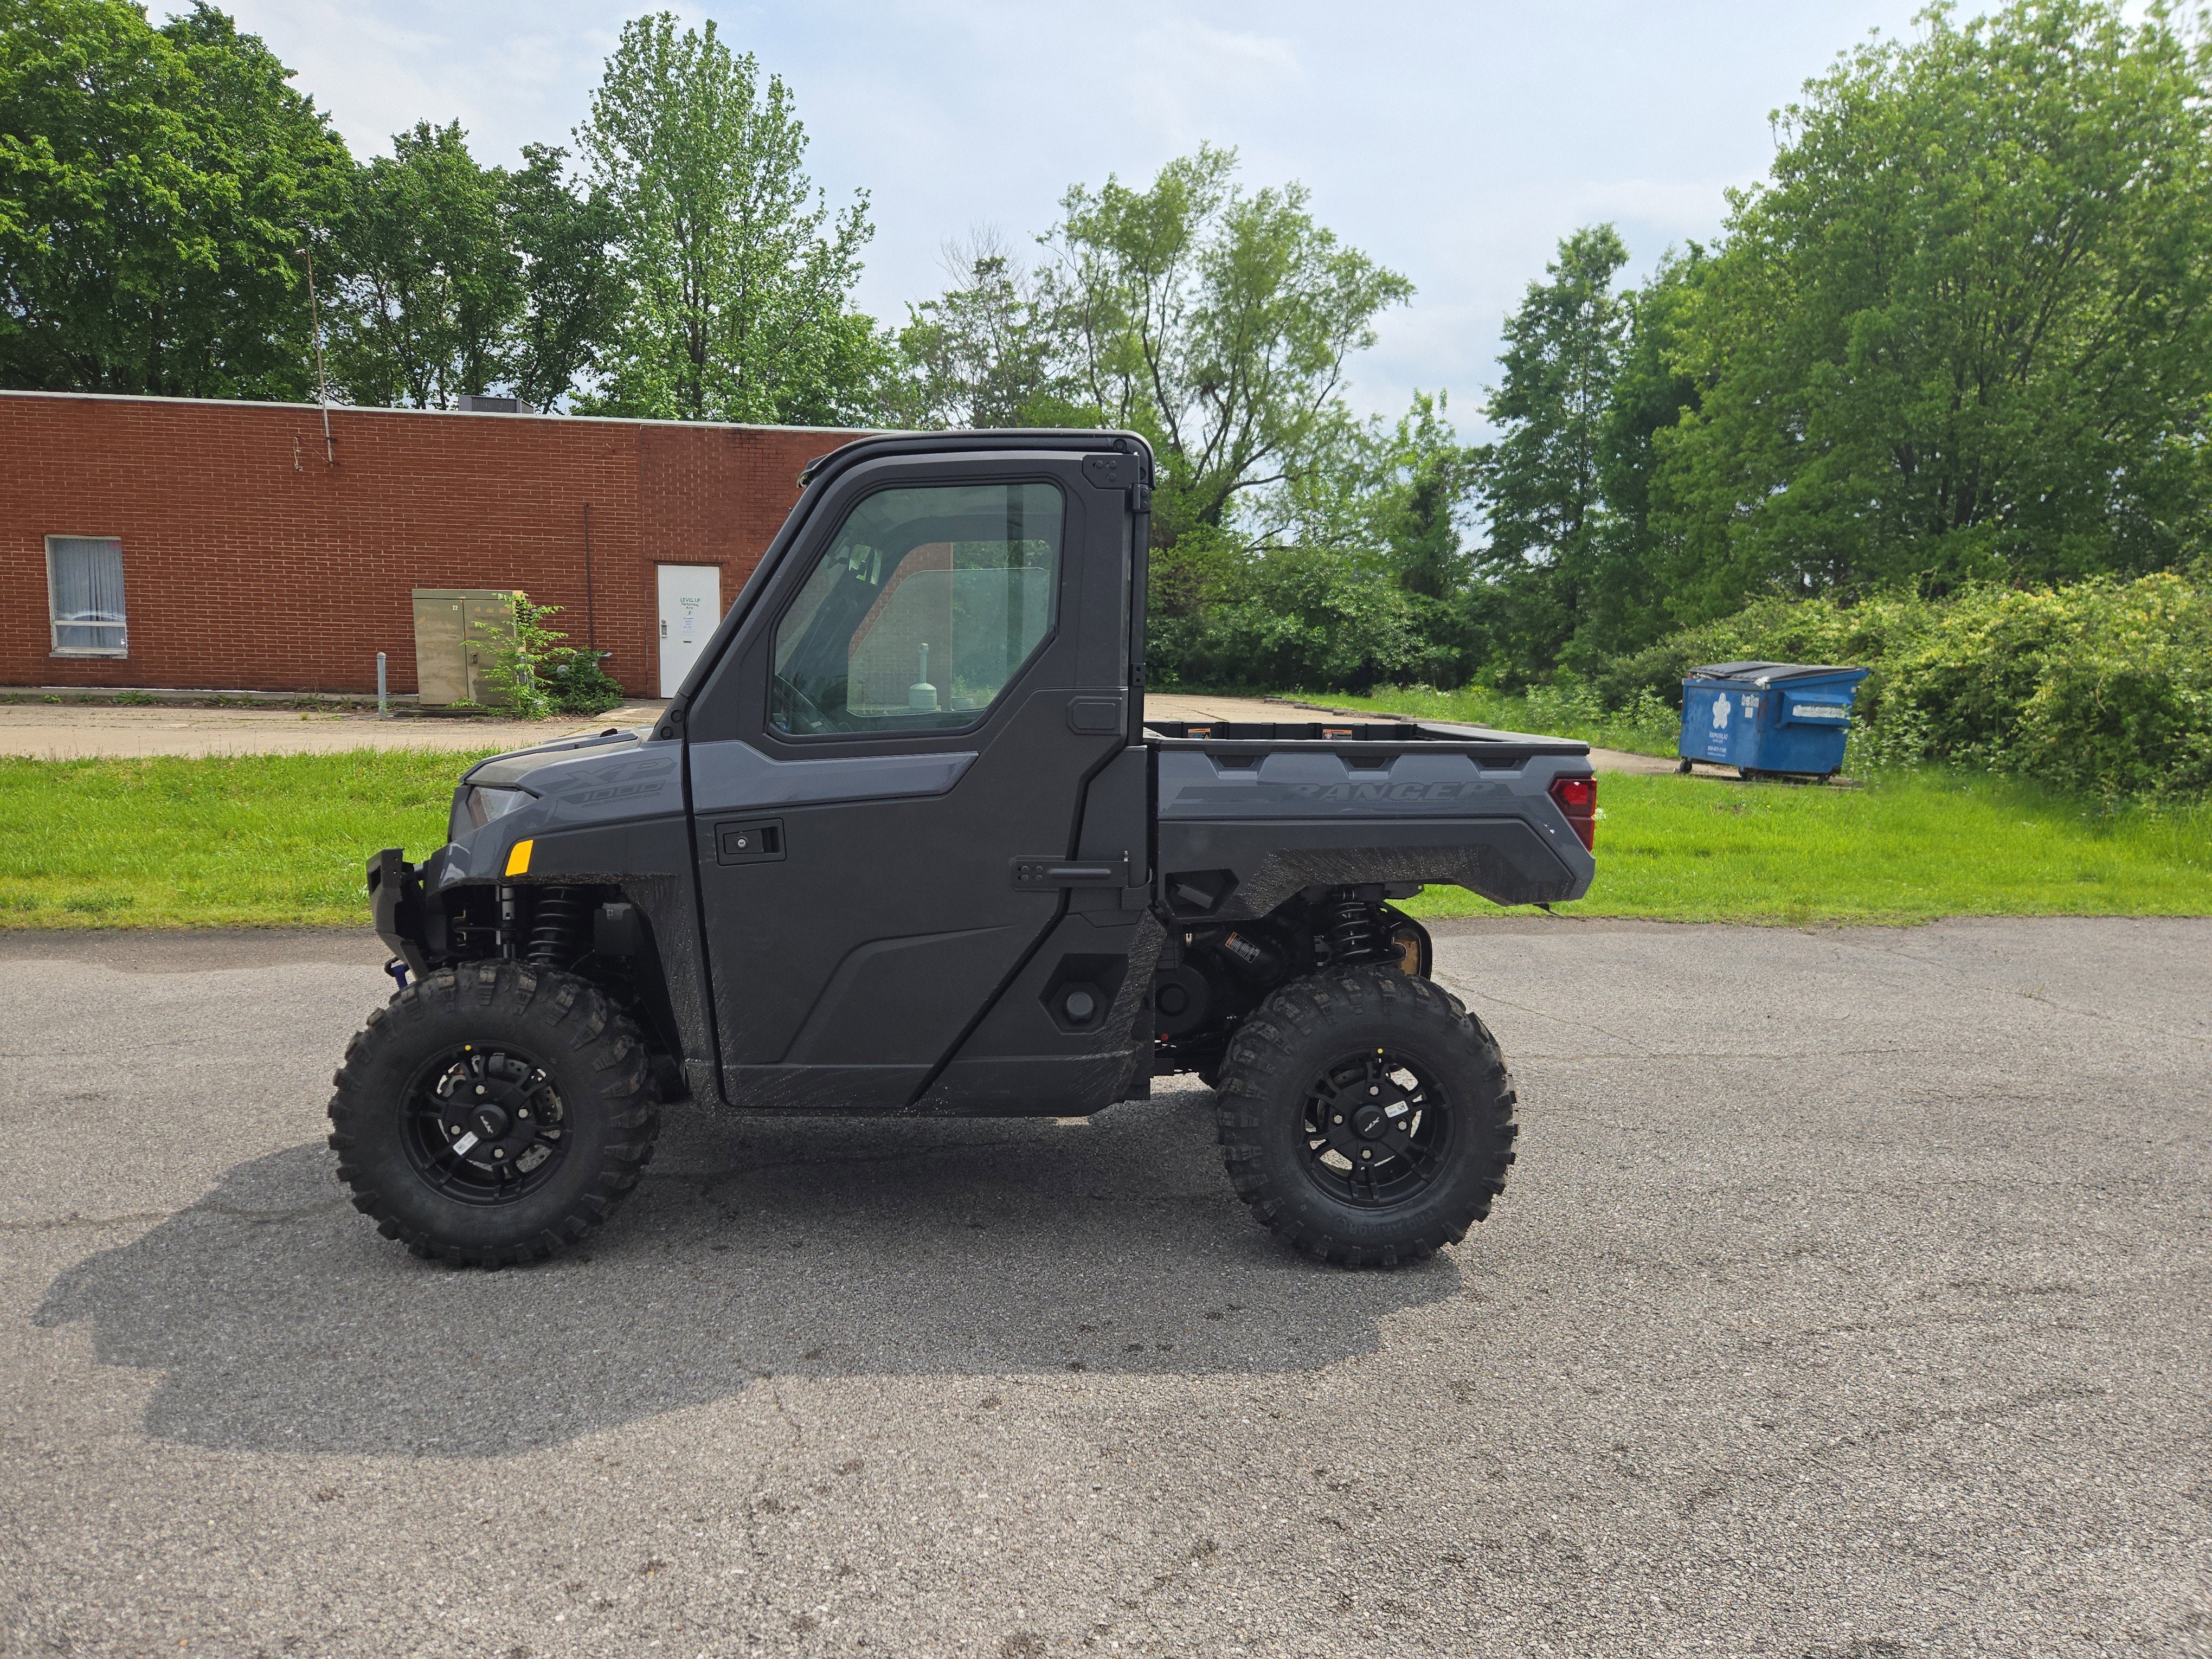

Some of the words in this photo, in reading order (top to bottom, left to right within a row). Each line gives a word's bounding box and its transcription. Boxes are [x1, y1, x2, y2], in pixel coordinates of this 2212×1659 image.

[552, 757, 676, 794] XP
[583, 779, 667, 802] 1000
[1287, 781, 1496, 802] RANGER
